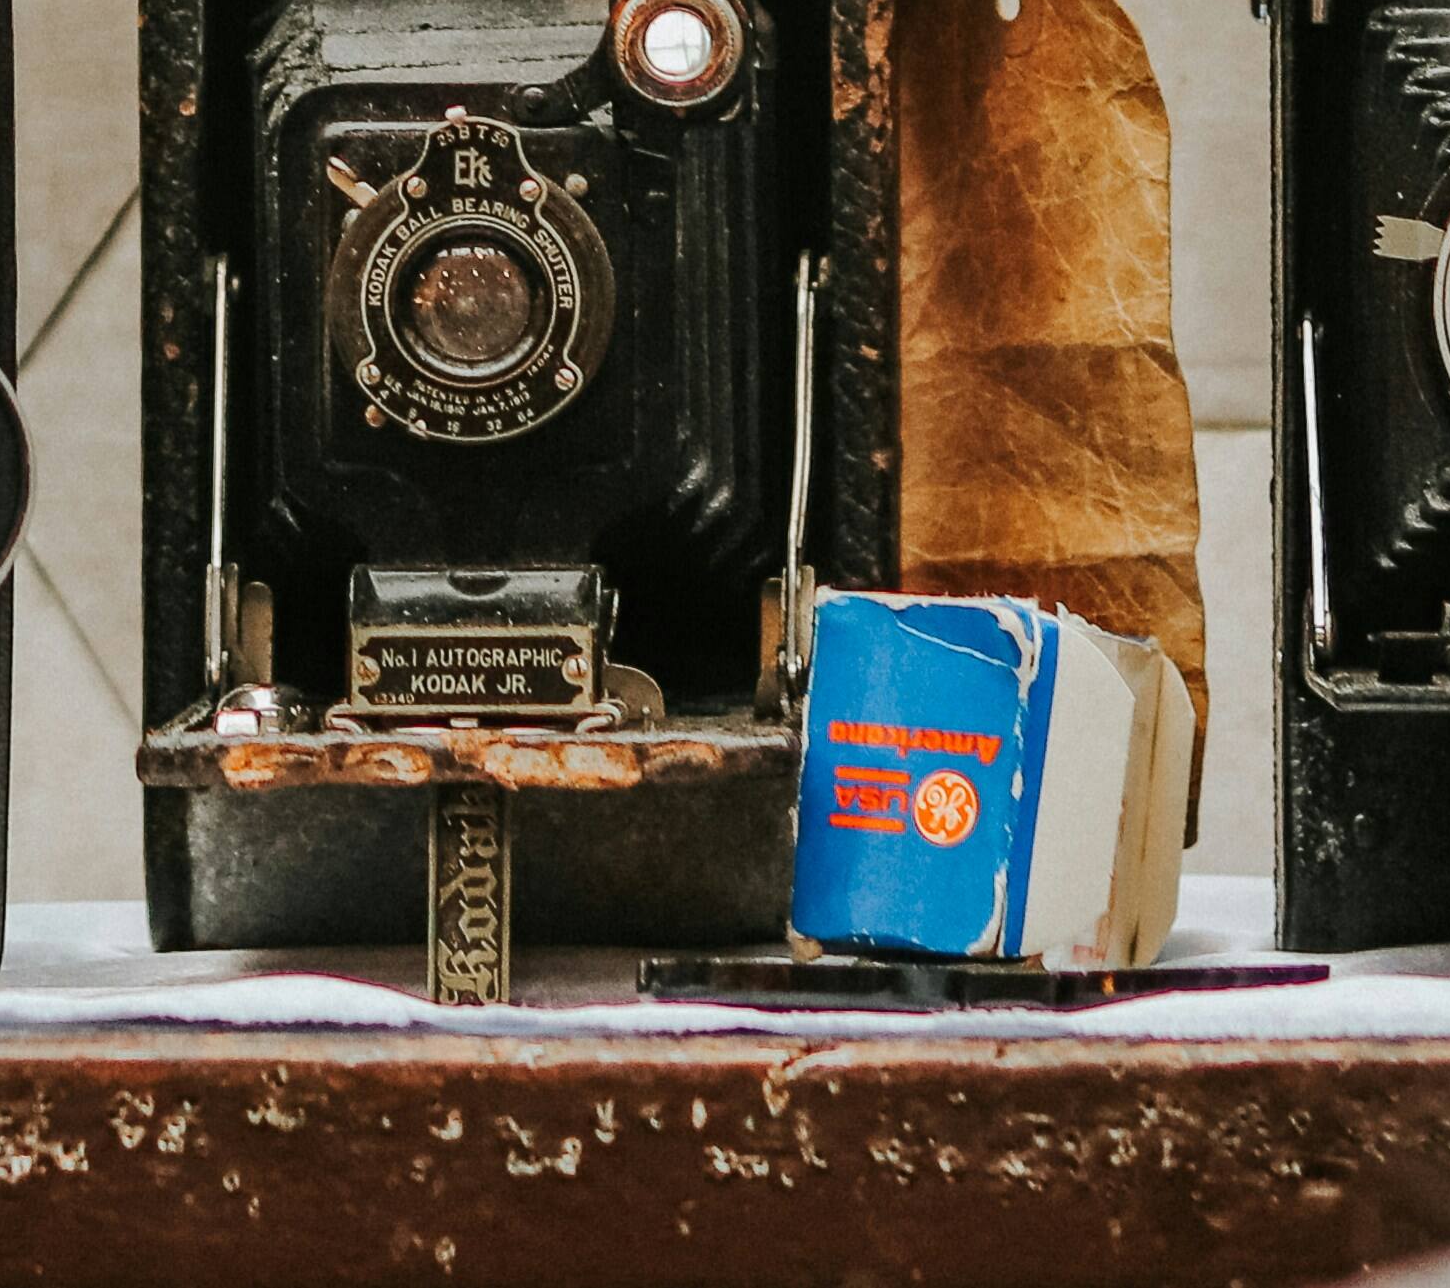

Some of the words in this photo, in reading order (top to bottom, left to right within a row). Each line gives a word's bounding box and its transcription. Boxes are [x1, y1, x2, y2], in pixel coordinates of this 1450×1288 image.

[367, 243, 399, 307] KODAK
[395, 206, 444, 242] BALL
[451, 197, 531, 230] BEARING
[533, 228, 575, 310] SHUTTER
[425, 648, 564, 669] AUTOGRAPHIC
[410, 674, 487, 695] KODAK
[496, 673, 533, 695] JR.
[834, 784, 910, 814] USA
